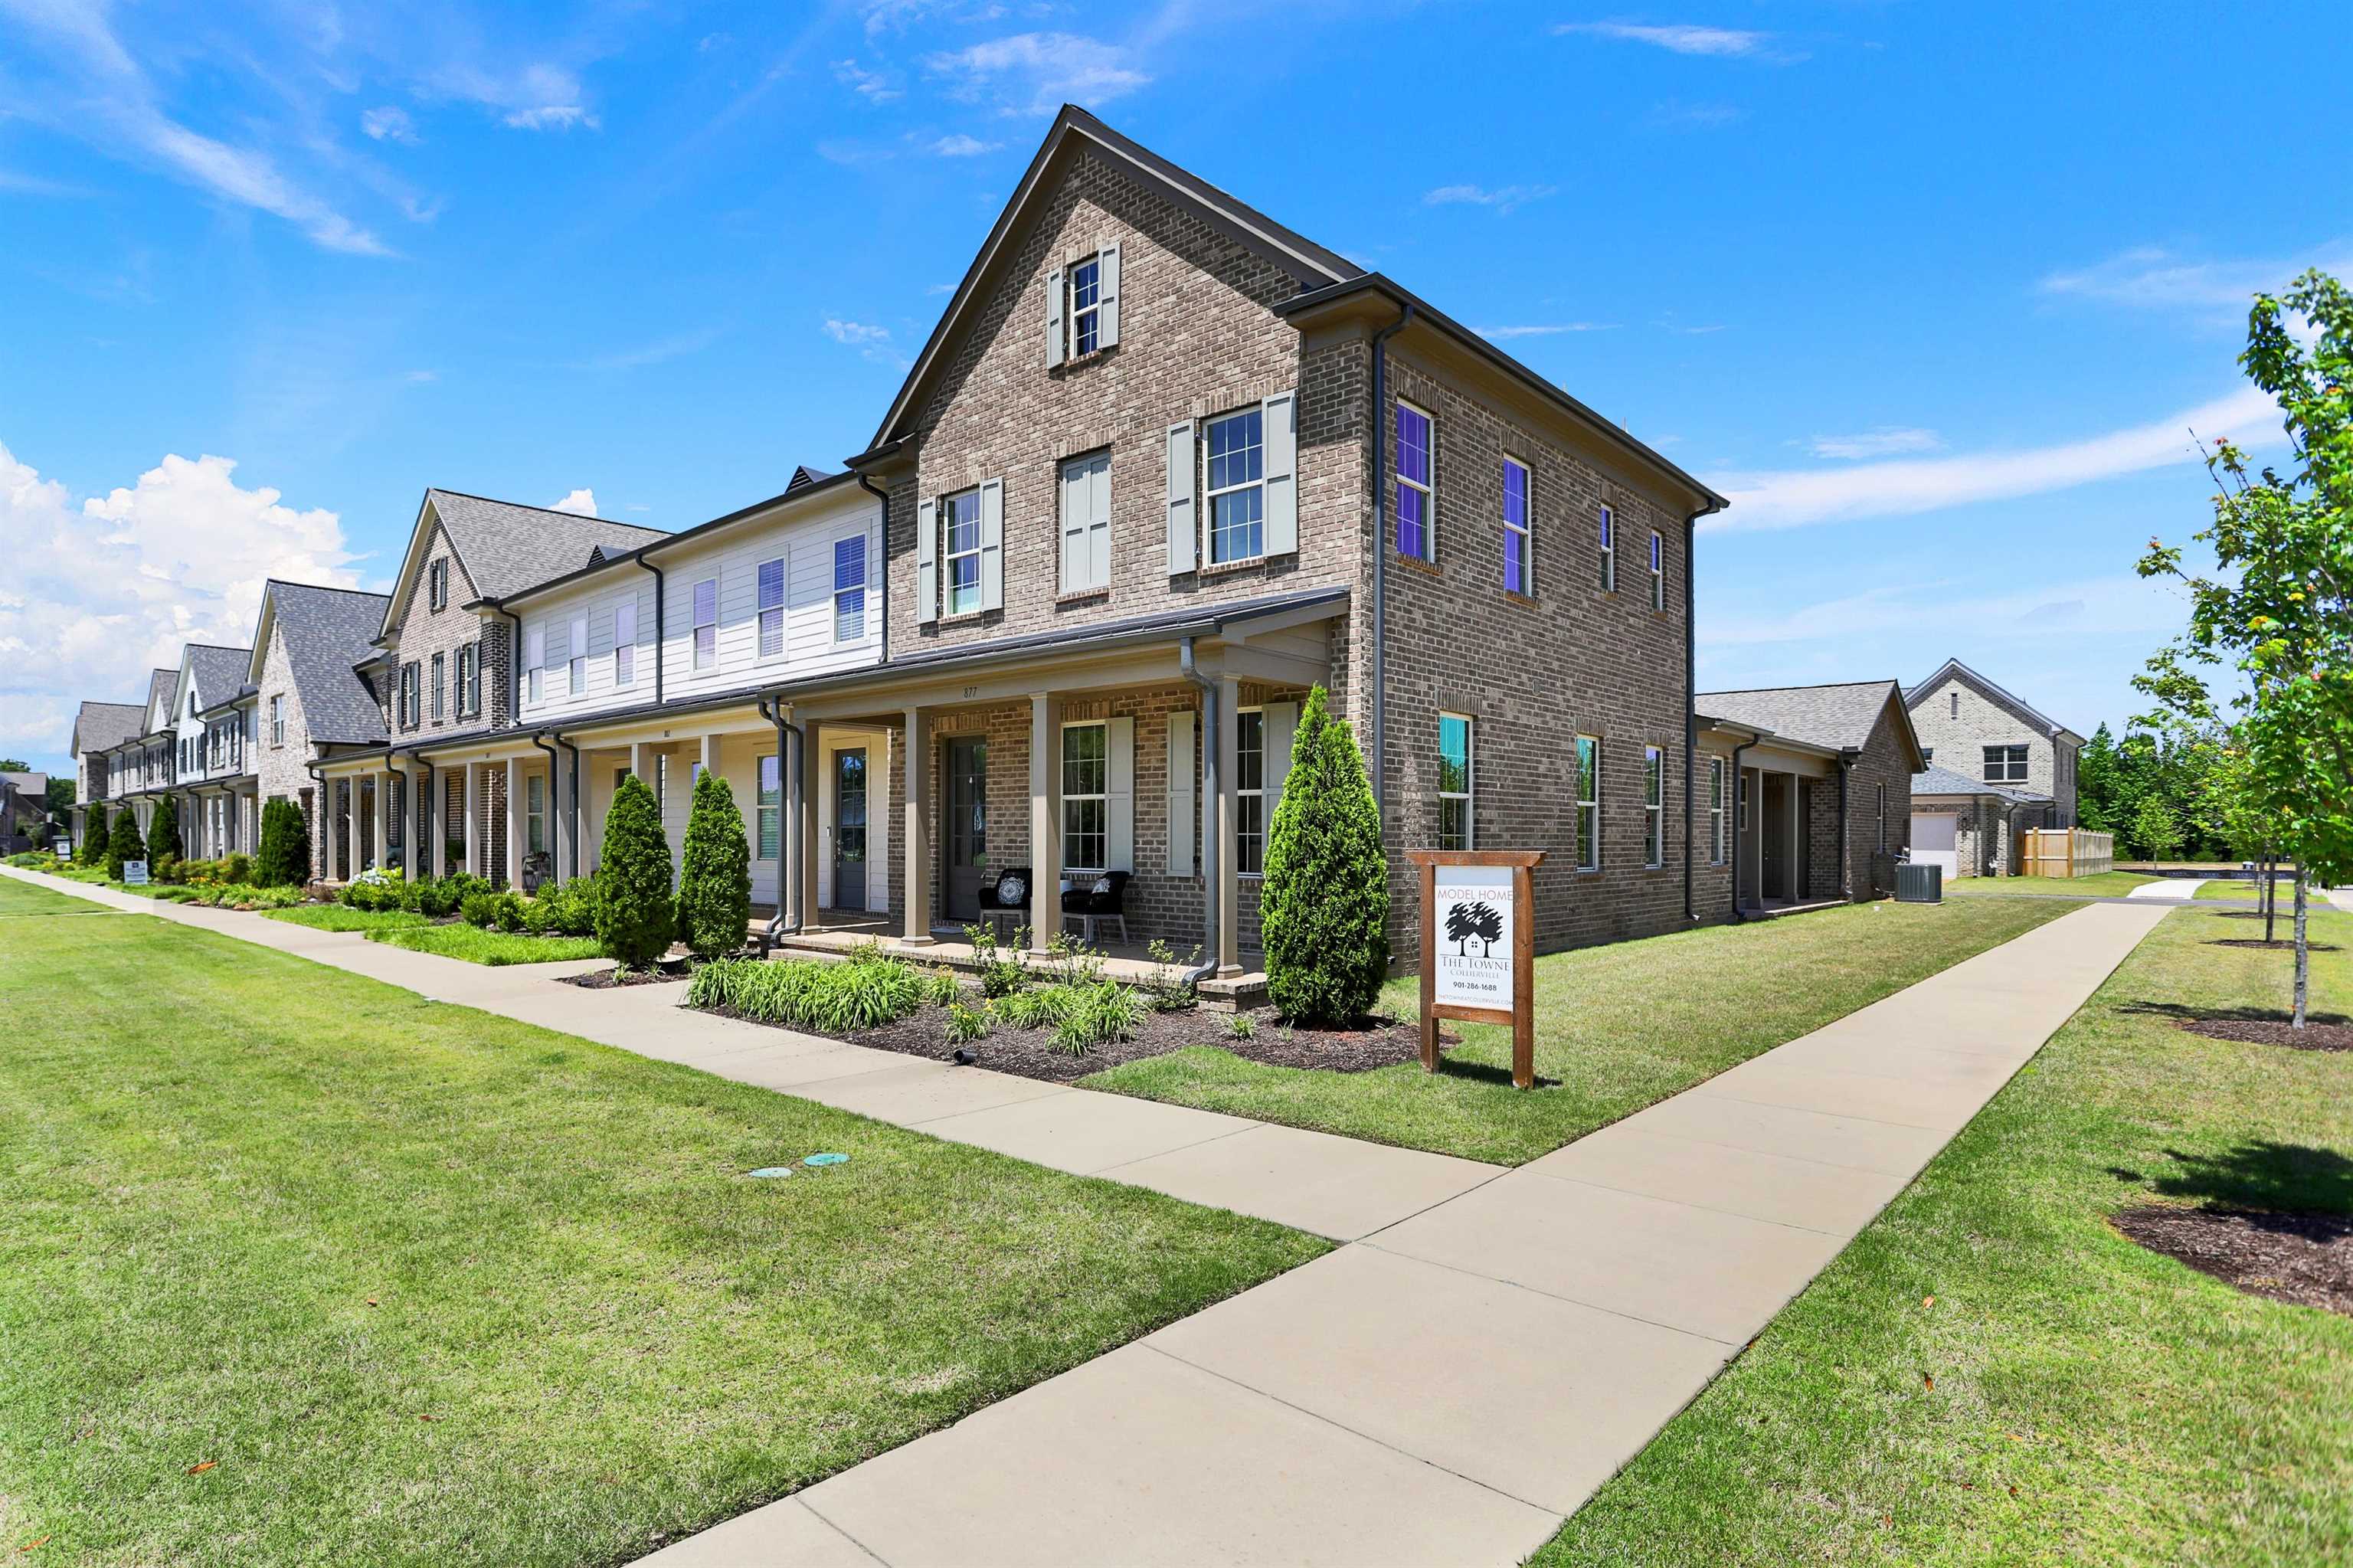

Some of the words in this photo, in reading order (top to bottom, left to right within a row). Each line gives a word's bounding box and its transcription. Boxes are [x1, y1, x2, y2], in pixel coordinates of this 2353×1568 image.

[964, 686, 977, 698] 877
[1438, 889, 1477, 900] MODEL
[1479, 889, 1514, 901] HOME
[1442, 956, 1464, 967] THE
[1467, 957, 1510, 971] TOWNE
[1453, 981, 1497, 991] 901-286-1688
